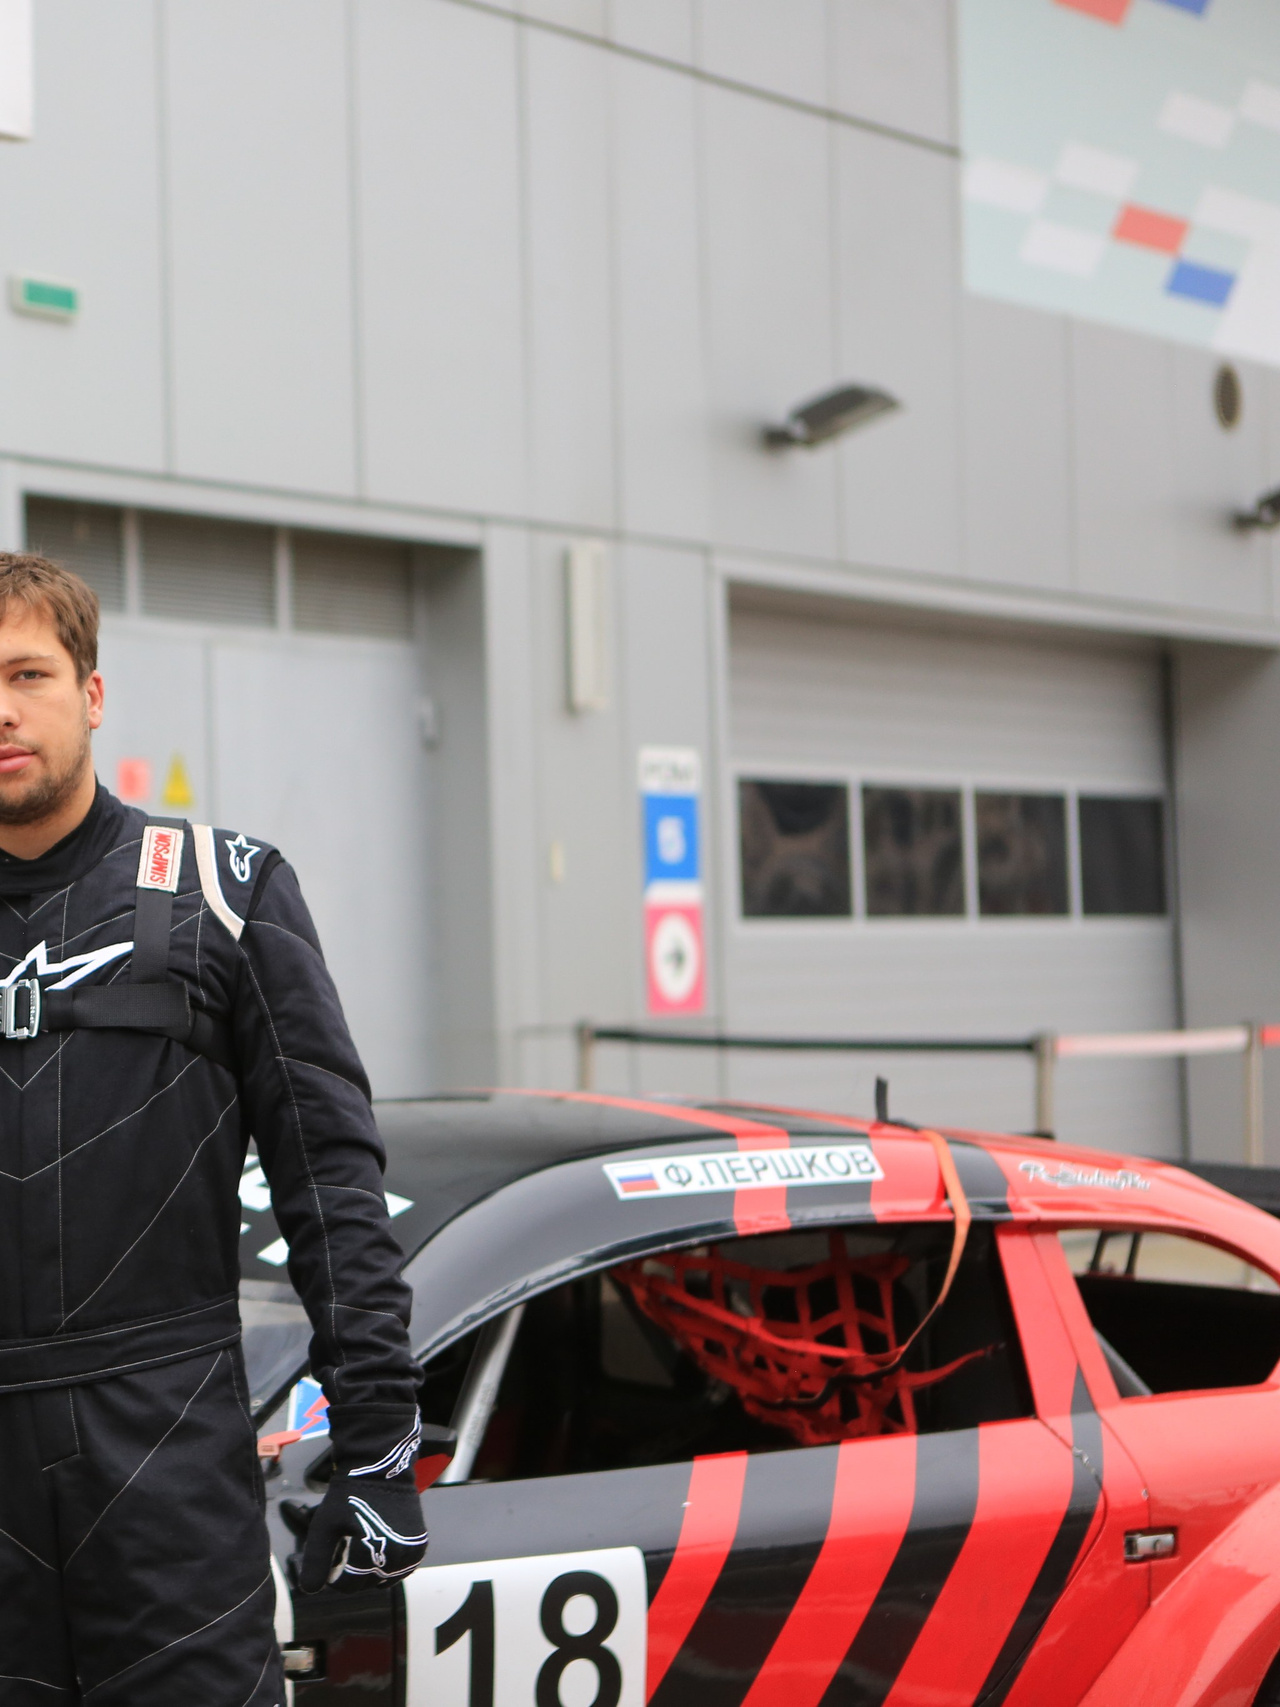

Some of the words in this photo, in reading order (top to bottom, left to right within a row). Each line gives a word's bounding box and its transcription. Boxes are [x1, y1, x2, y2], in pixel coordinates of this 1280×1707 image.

[149, 832, 172, 884] SIMPSON
[663, 1150, 876, 1188] Ф.ПЕРШКОВ
[434, 1569, 623, 1707] 18
